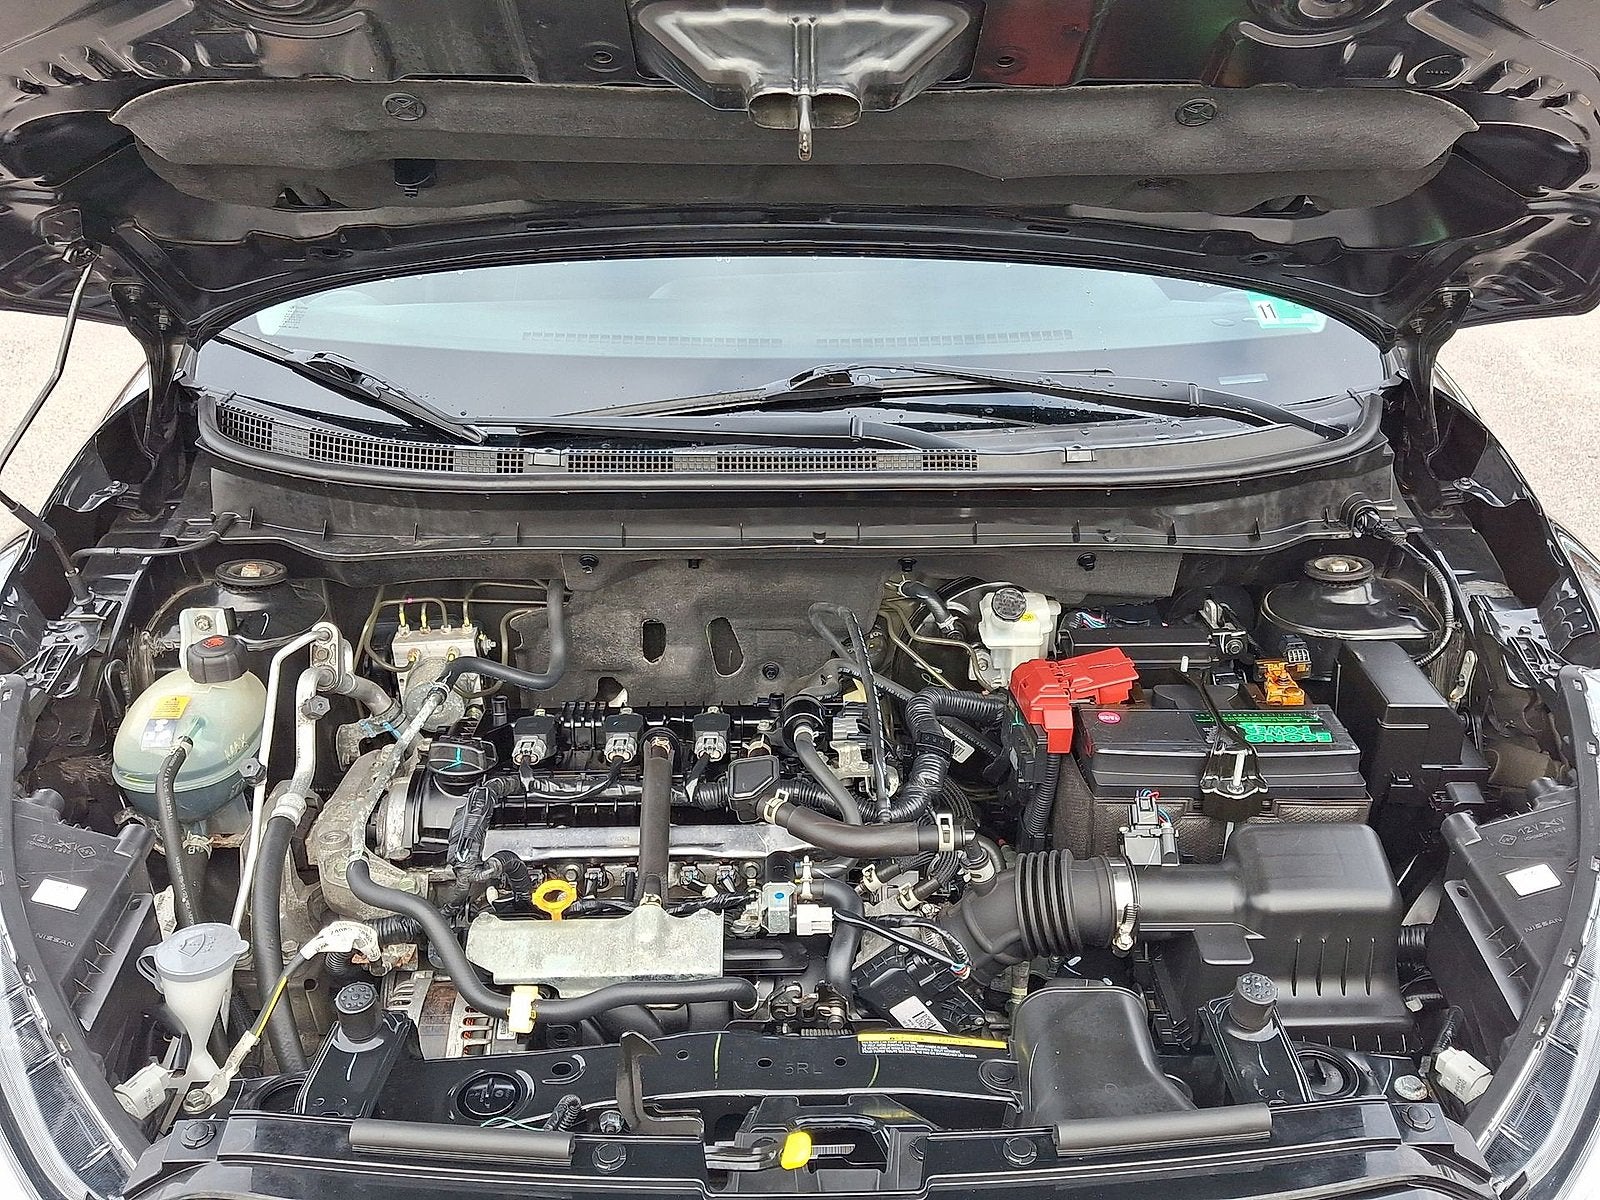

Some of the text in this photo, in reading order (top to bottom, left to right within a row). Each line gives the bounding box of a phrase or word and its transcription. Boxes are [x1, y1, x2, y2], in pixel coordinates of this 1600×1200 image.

[1245, 724, 1312, 735] POWER
[1245, 732, 1333, 743] ECONO
[1523, 916, 1564, 934] NISSAN
[35, 932, 76, 948] NISSAN
